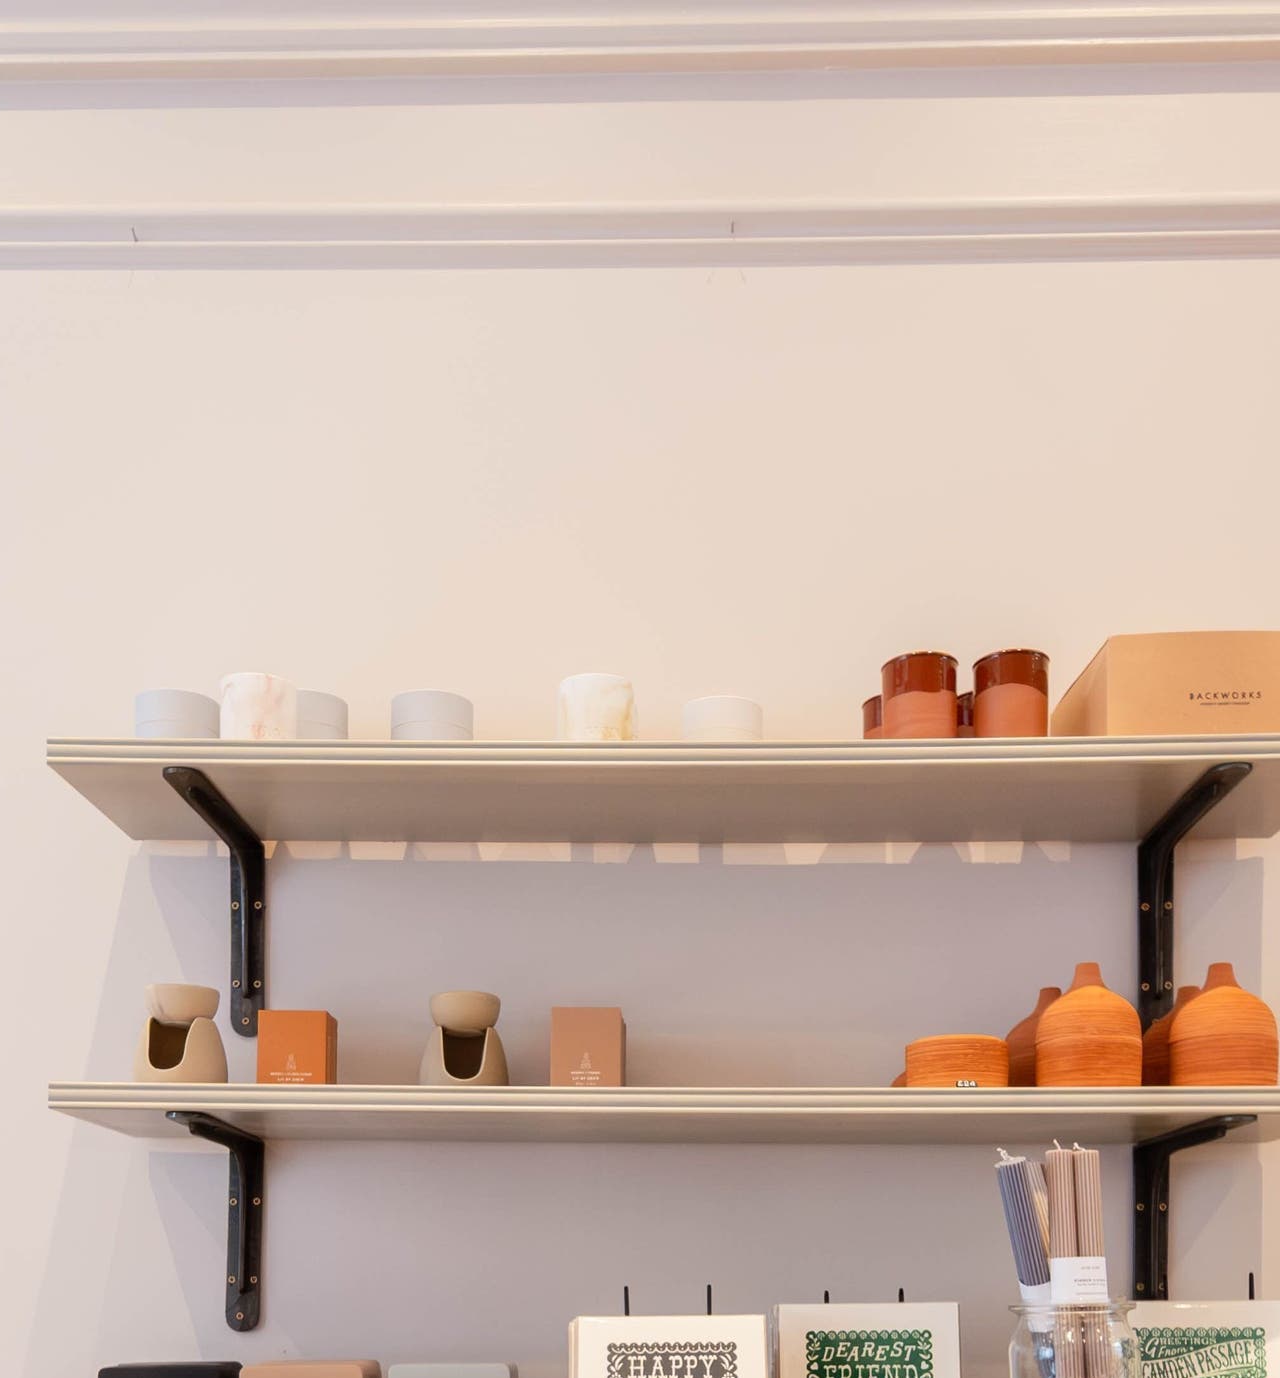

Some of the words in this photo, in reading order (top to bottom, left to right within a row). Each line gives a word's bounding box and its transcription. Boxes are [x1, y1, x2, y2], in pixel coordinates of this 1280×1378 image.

[1189, 691, 1262, 700] BACKWORKS
[821, 1341, 916, 1362] DEAREST
[1145, 1337, 1216, 1358] GREETINGS
[1197, 1341, 1254, 1375] PASSAGE
